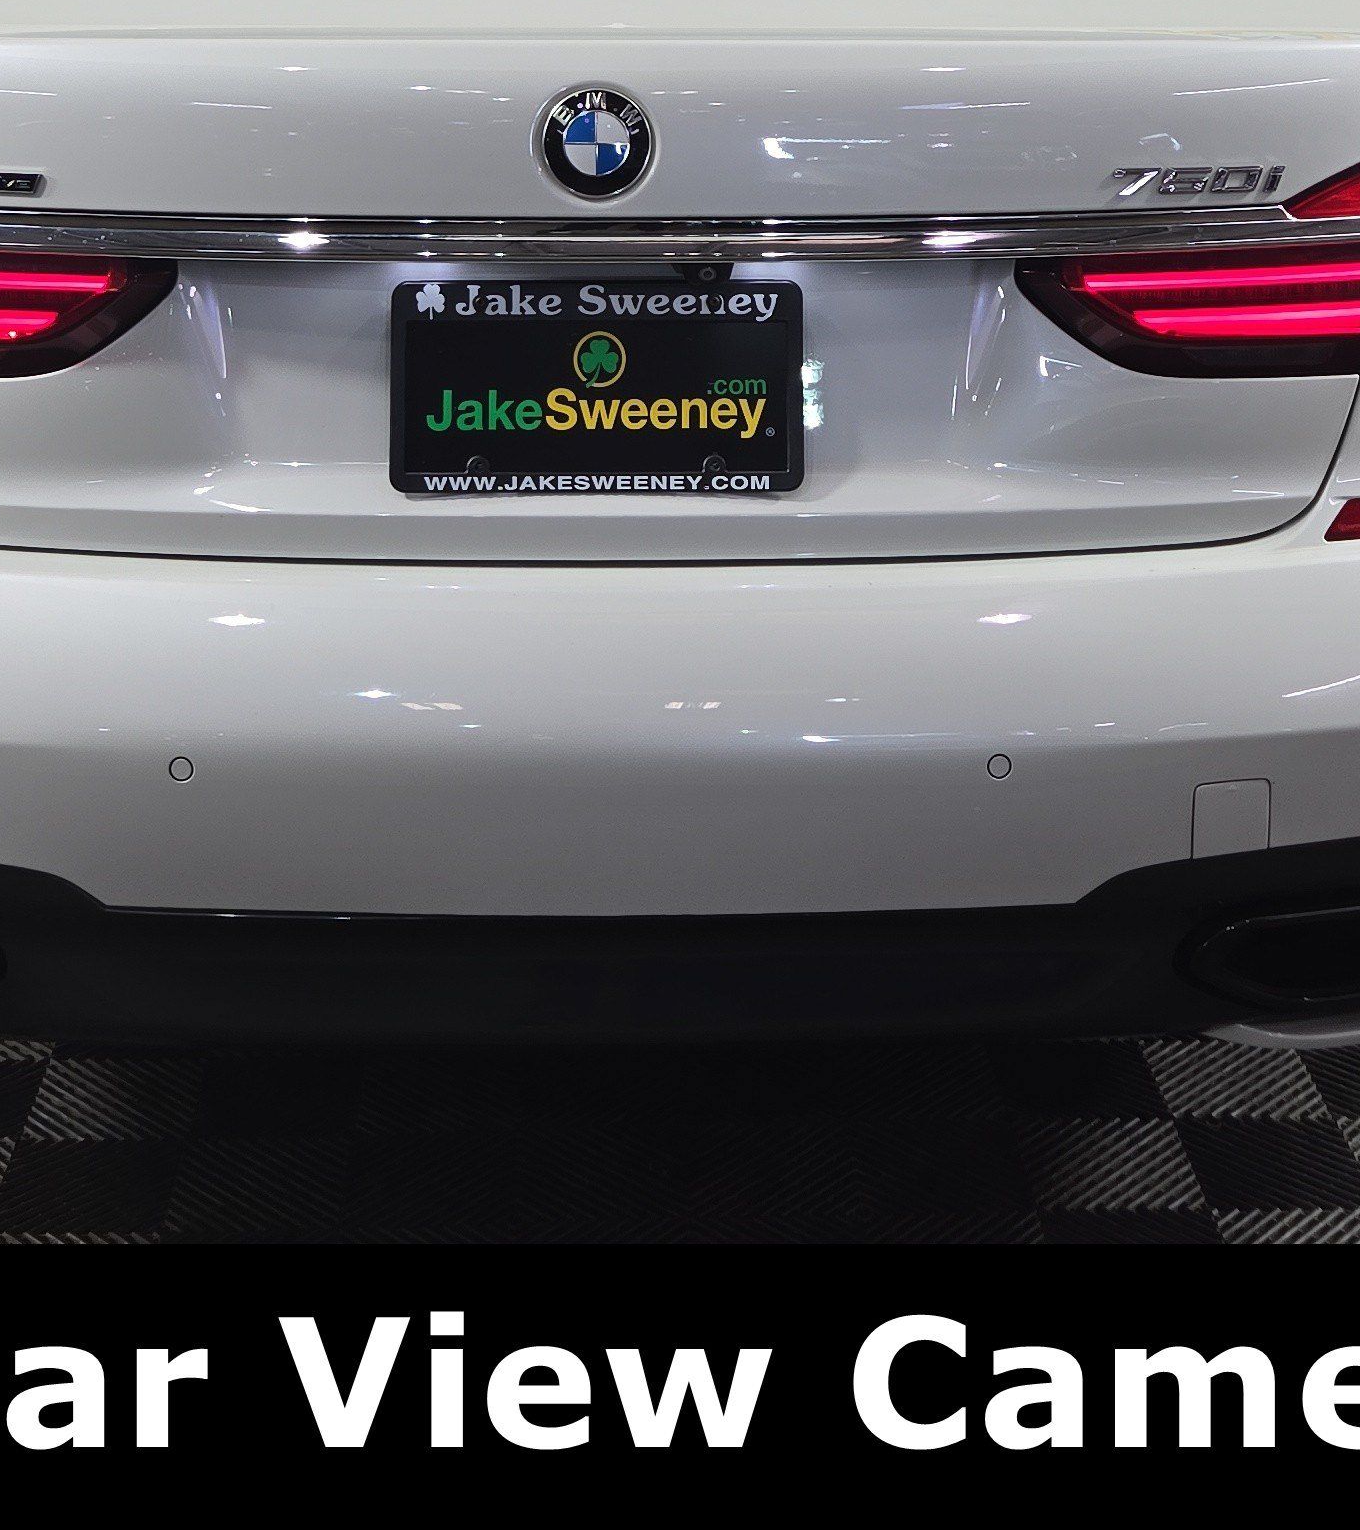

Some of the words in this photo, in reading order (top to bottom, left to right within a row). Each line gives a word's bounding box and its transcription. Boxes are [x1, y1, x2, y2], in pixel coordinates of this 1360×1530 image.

[1113, 165, 1286, 197] 750i
[455, 284, 563, 316] Jake
[577, 284, 779, 322] Sweeney
[706, 377, 767, 396] .com
[426, 388, 767, 439] JakeSweeney
[424, 475, 771, 491] WWW.JAKESWEENEY.COM
